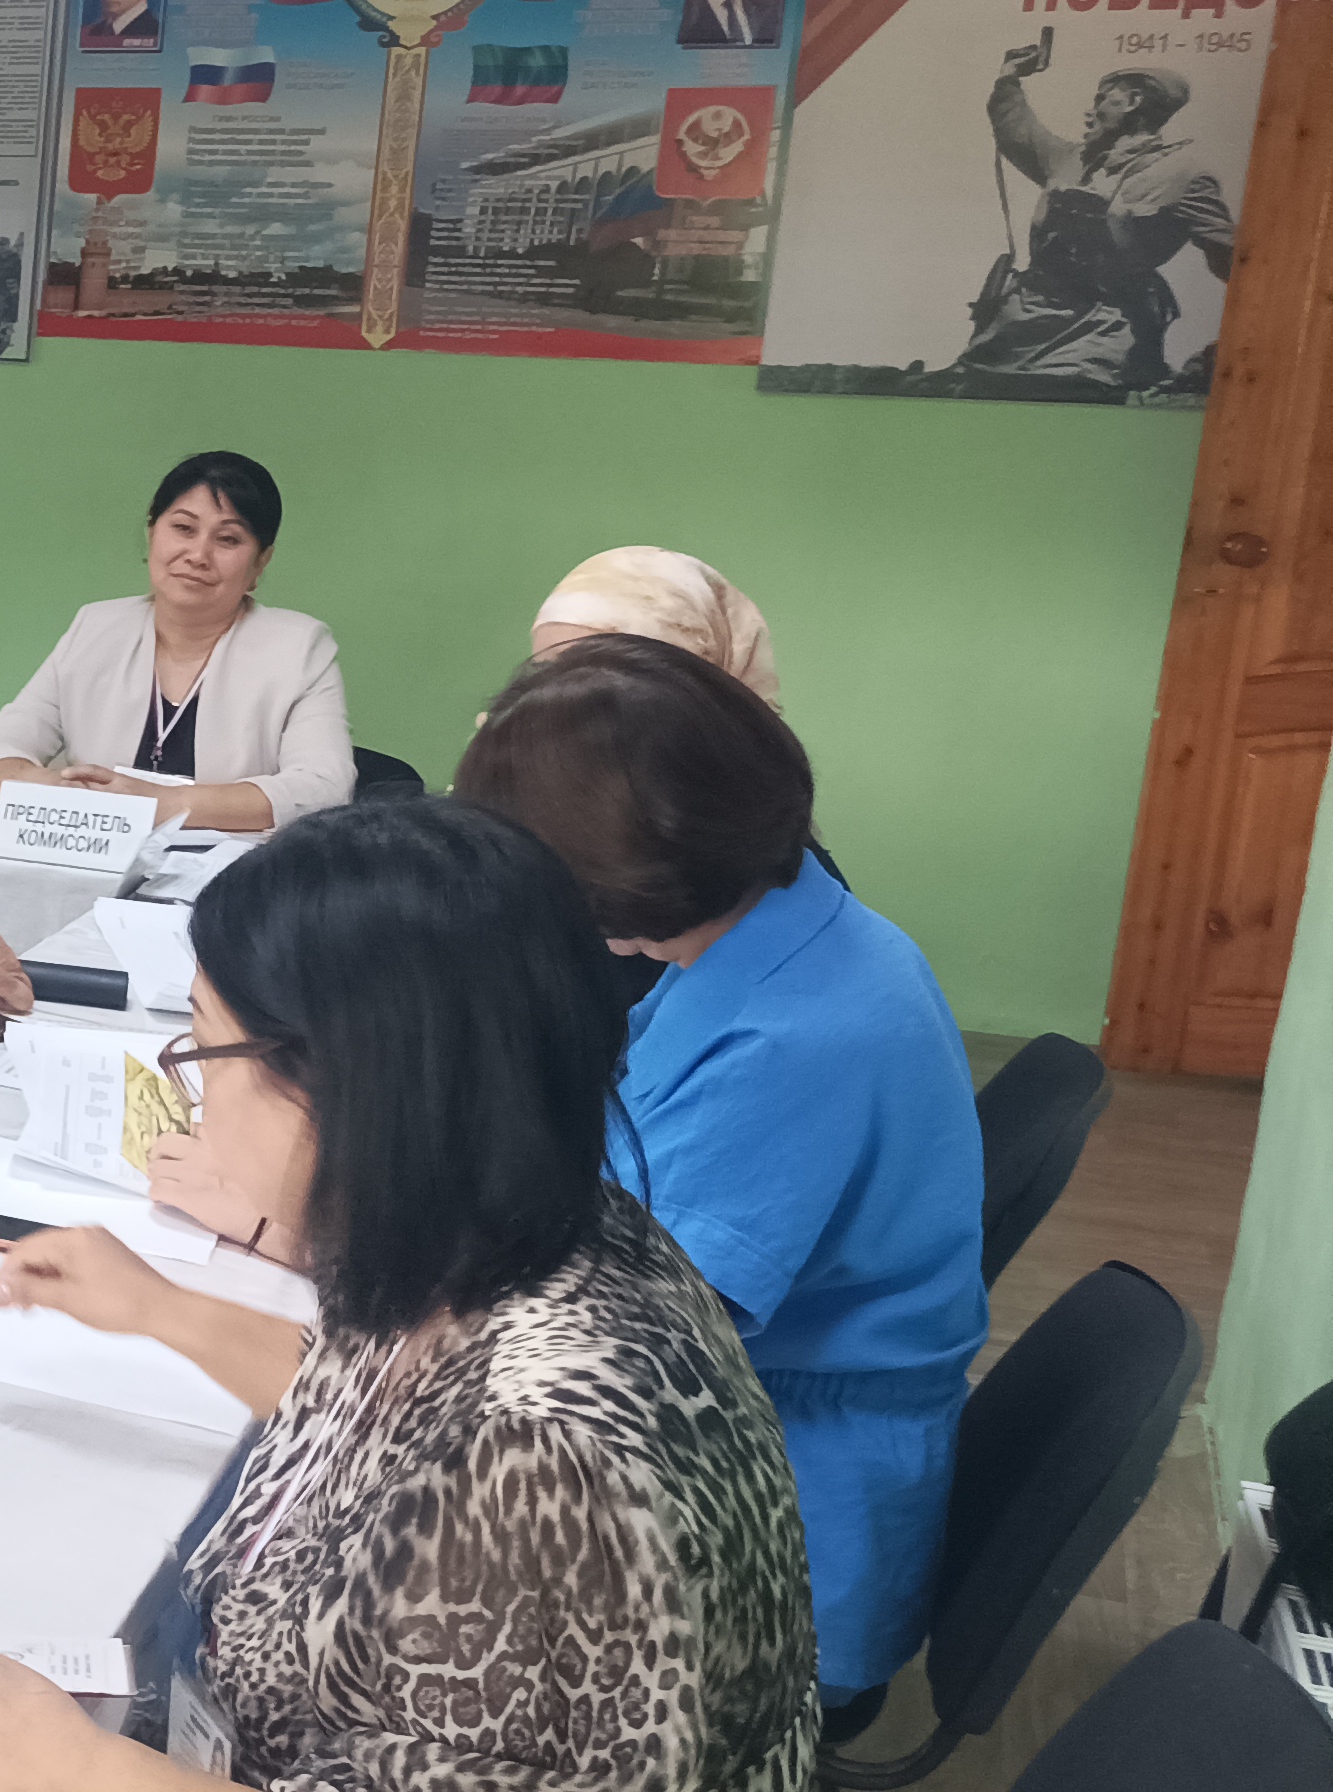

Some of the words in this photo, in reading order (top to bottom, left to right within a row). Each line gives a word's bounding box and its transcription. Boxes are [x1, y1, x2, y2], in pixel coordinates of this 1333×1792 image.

[1114, 33, 1170, 54] 1941
[1194, 32, 1252, 54] 1945
[3, 803, 132, 834] ПРЕДСЕДАТЕЛЬ
[15, 827, 110, 856] КОМИССИИ
